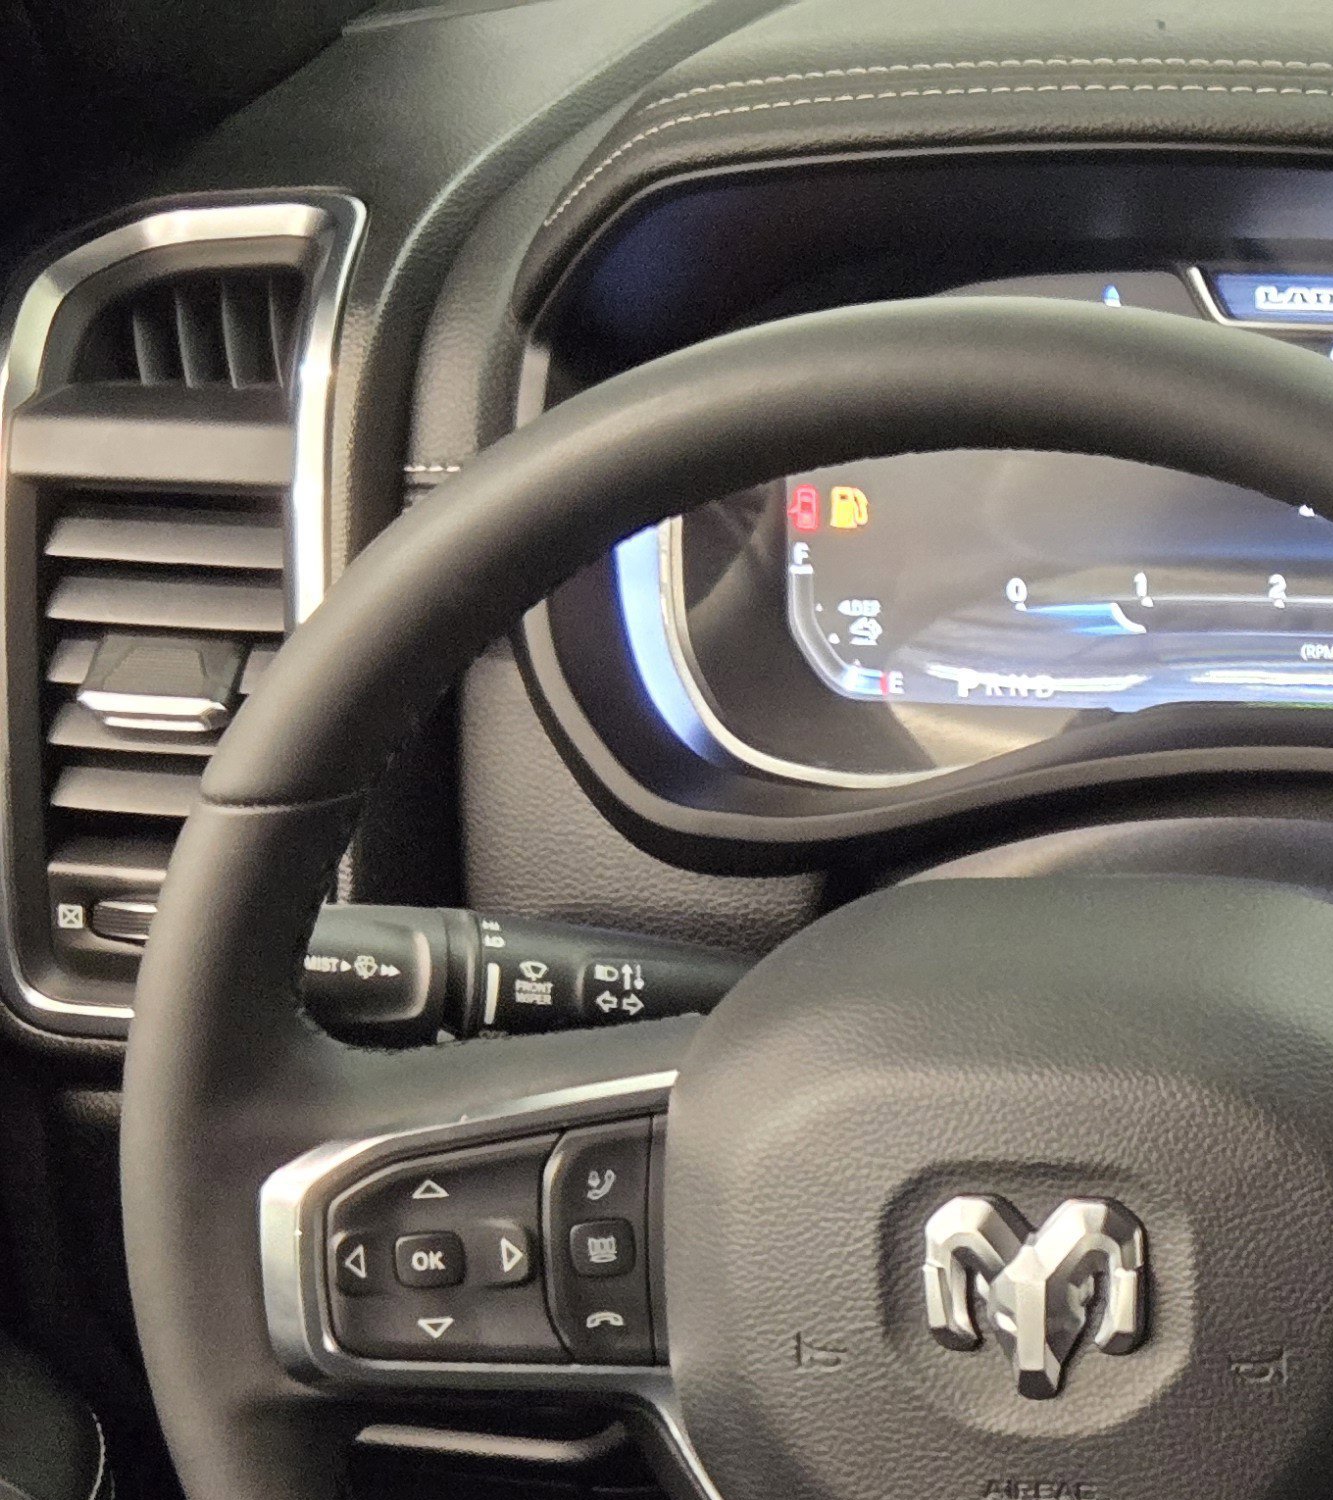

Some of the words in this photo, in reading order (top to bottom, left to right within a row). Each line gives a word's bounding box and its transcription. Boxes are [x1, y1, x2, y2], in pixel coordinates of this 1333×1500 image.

[1005, 577, 1028, 604] 0
[1134, 572, 1148, 598] 1
[1268, 574, 1287, 600] 2
[411, 1251, 446, 1271] OK
